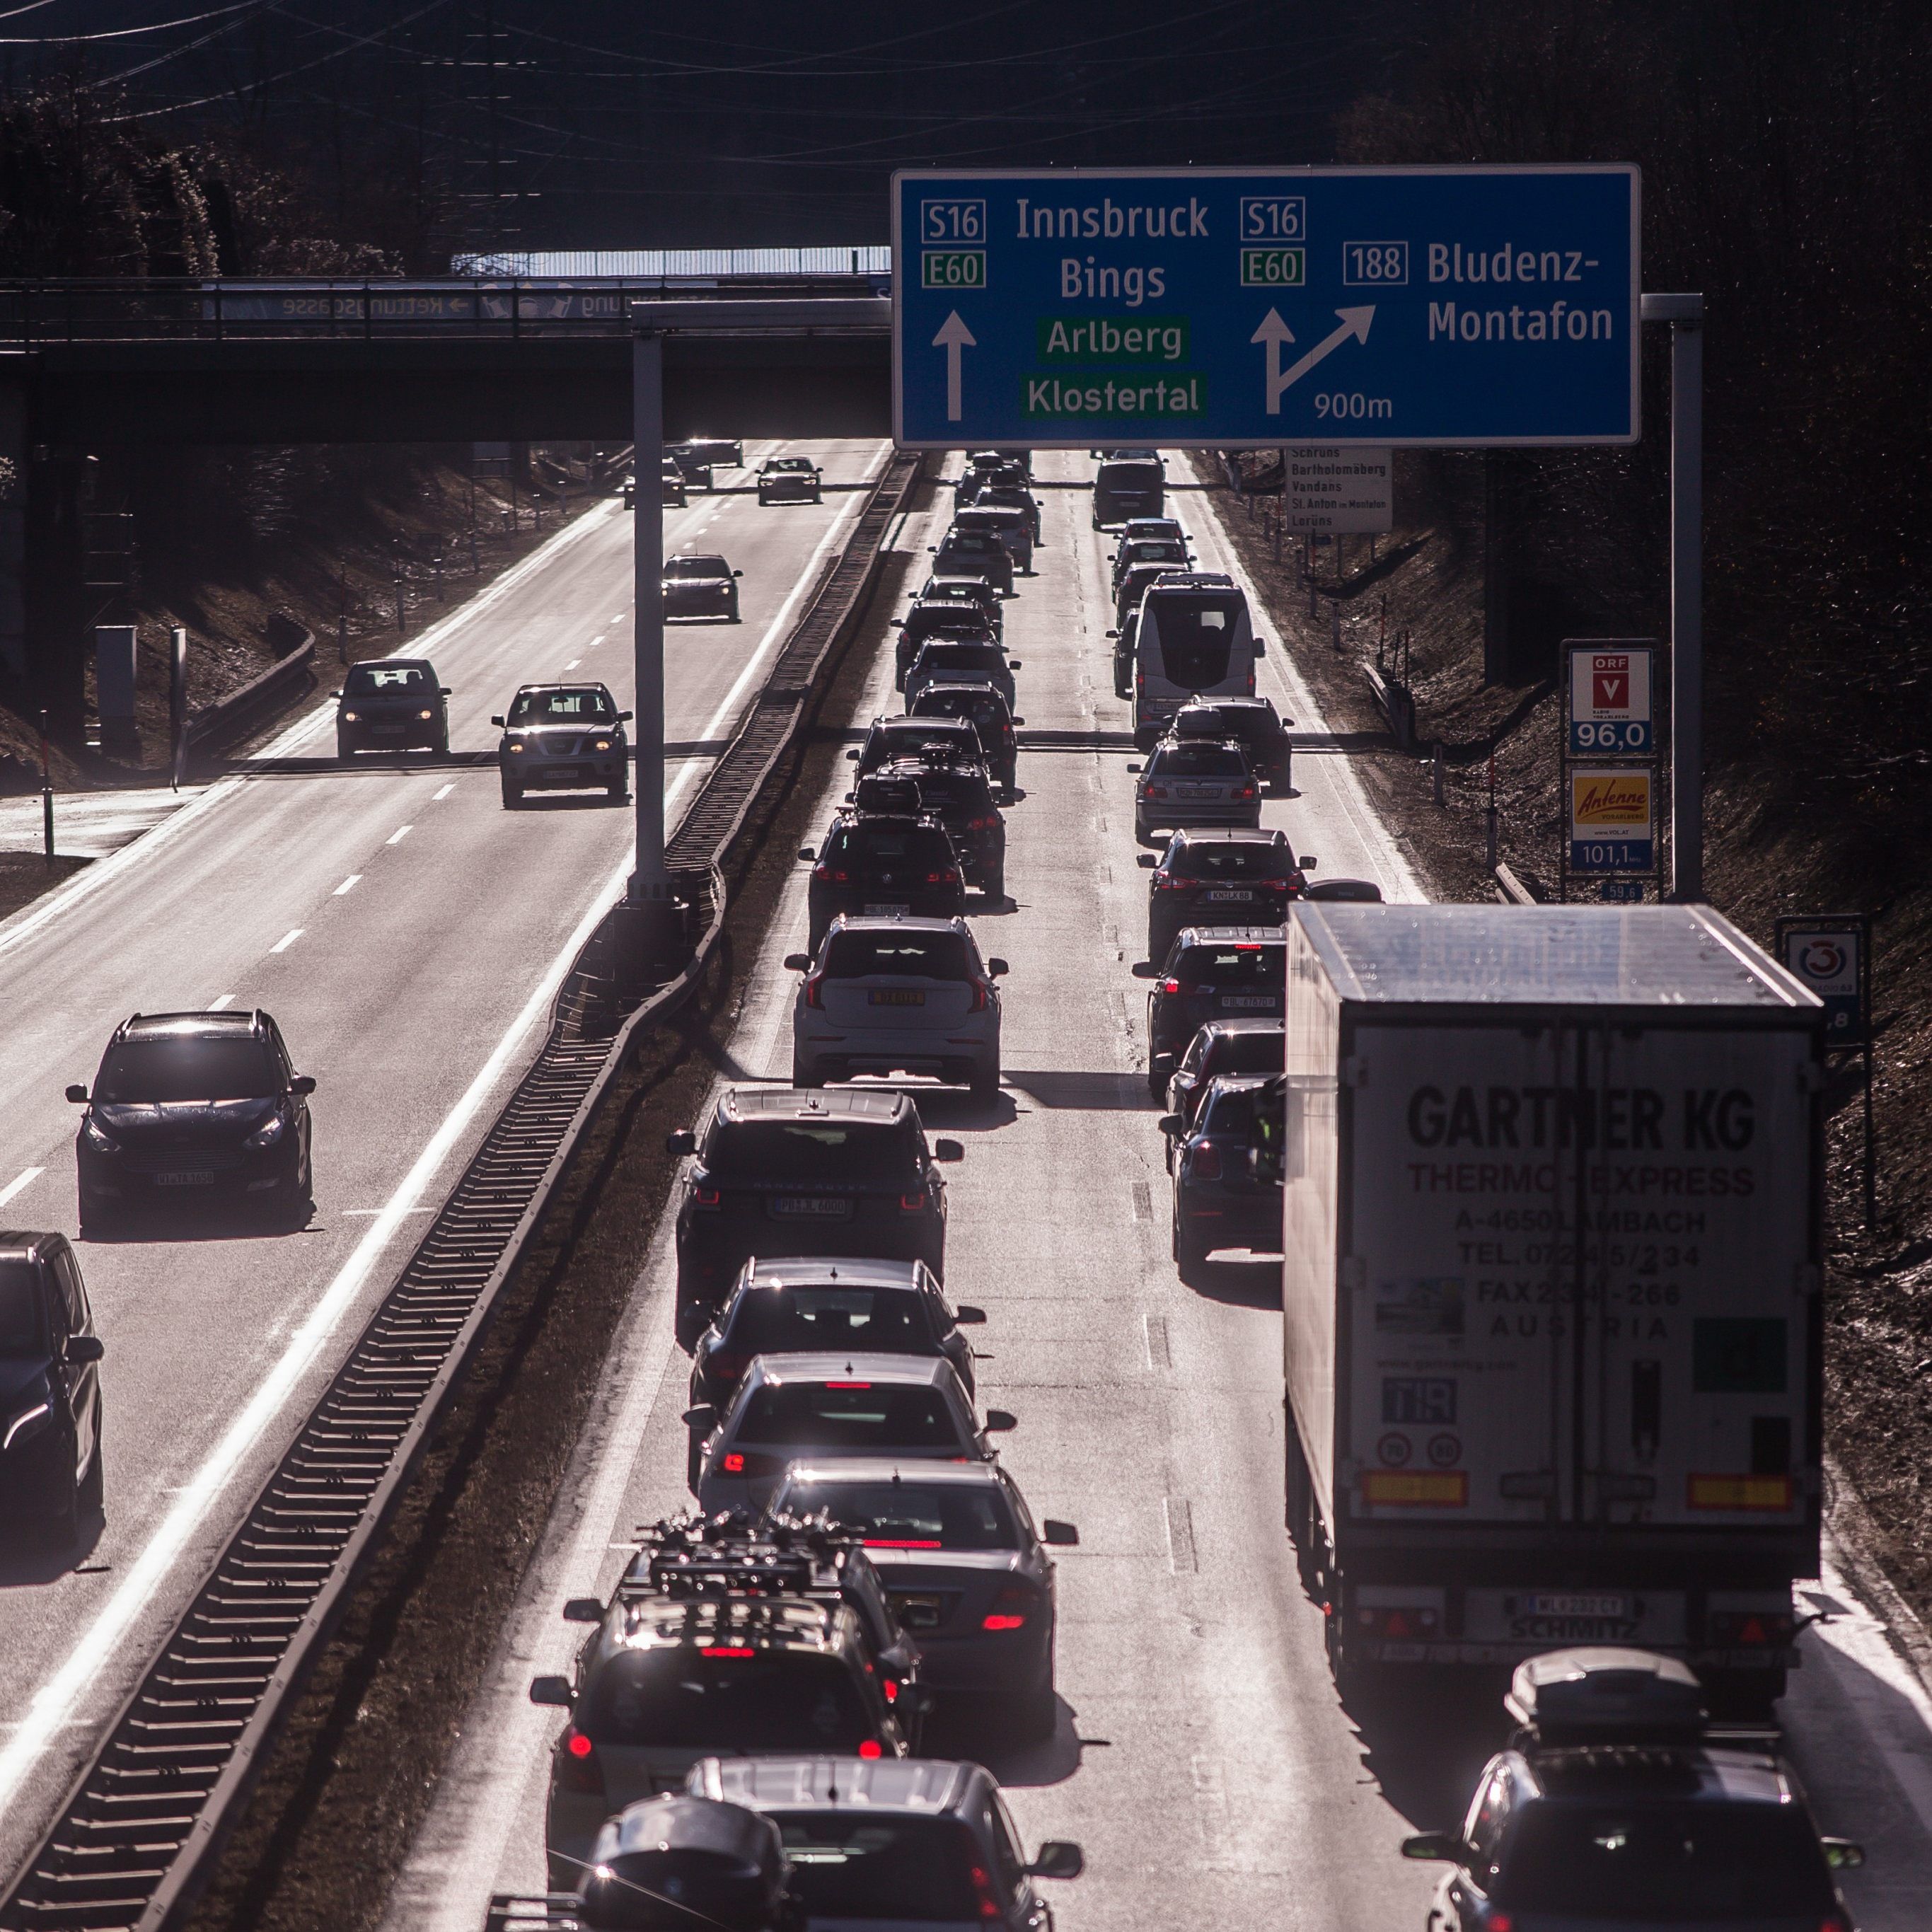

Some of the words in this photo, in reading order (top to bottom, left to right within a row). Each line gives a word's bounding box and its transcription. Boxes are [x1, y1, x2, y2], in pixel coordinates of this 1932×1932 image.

[929, 205, 979, 238] S16
[1017, 197, 1210, 238] Innsbruck
[1247, 202, 1299, 236] S16
[930, 255, 978, 284] E60
[1248, 252, 1298, 282] E60
[1350, 246, 1401, 280] 188
[1428, 242, 1600, 283] Bludenz-
[1061, 255, 1166, 307] Bings
[1428, 300, 1613, 341] Montafon
[1046, 320, 1182, 360] Arlberg
[1029, 378, 1200, 412] Klostertal
[1314, 393, 1393, 419] 900m
[1292, 463, 1387, 478] Bartholomäberg
[1292, 480, 1343, 492] Vandans
[1292, 498, 1306, 509] St.
[1307, 498, 1337, 509] Anton
[1349, 499, 1387, 509] Montafon
[1292, 514, 1332, 526] Lorüns
[1595, 658, 1626, 669] ORF
[1601, 678, 1621, 702] V
[1577, 722, 1645, 751] 96,0
[1577, 778, 1647, 816] Antenne
[1583, 845, 1629, 866] 101,1
[1407, 1085, 1664, 1151] GARTNER
[1684, 1089, 1756, 1152] KG
[1591, 1166, 1756, 1198] EXPRESS
[1454, 1210, 1554, 1232] A-4650
[1556, 1211, 1706, 1234] LAMBACH
[1477, 1281, 1531, 1304] FAX
[1389, 1382, 1451, 1421] TIR
[1510, 1619, 1637, 1638] SCHMITZ
